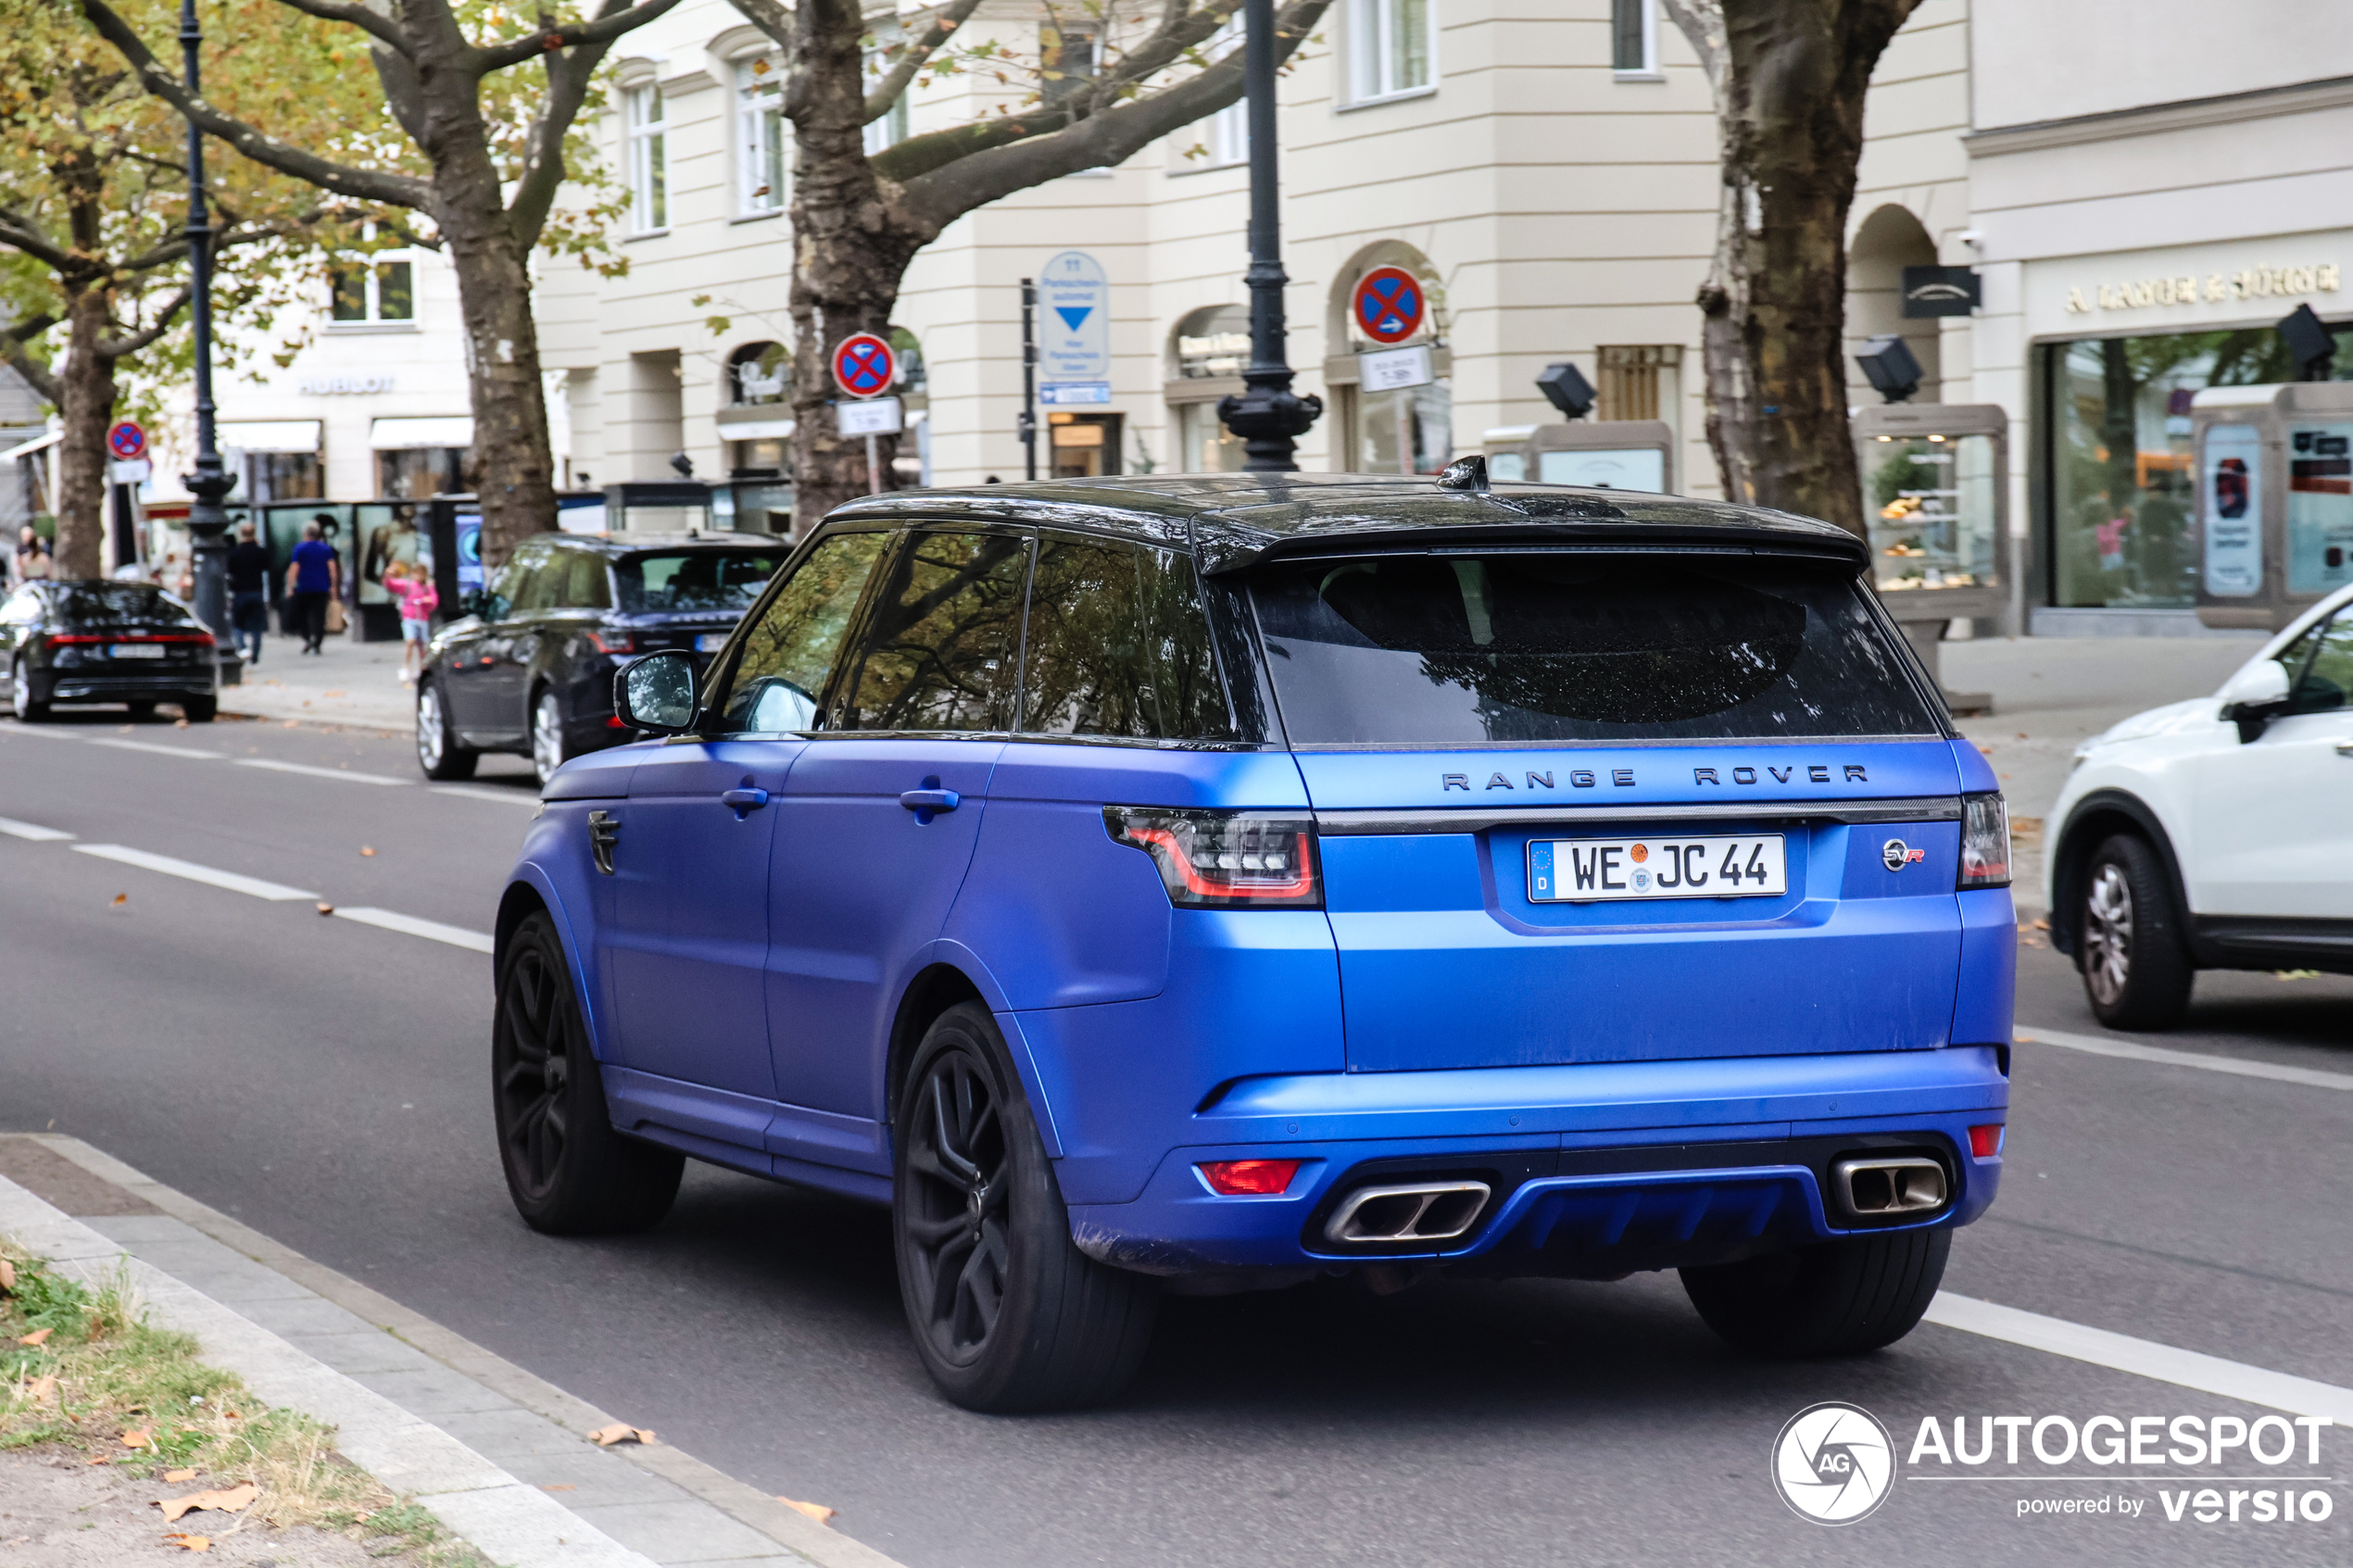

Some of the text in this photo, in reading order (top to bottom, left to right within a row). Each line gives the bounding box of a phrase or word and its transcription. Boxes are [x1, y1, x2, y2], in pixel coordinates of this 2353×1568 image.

[1441, 765, 1869, 791] RANGE ROVER
[1882, 848, 1925, 863] SVR
[1572, 847, 1627, 890] WE
[1657, 844, 1708, 888] JC
[1719, 843, 1768, 886] 44
[1538, 877, 1547, 890] D
